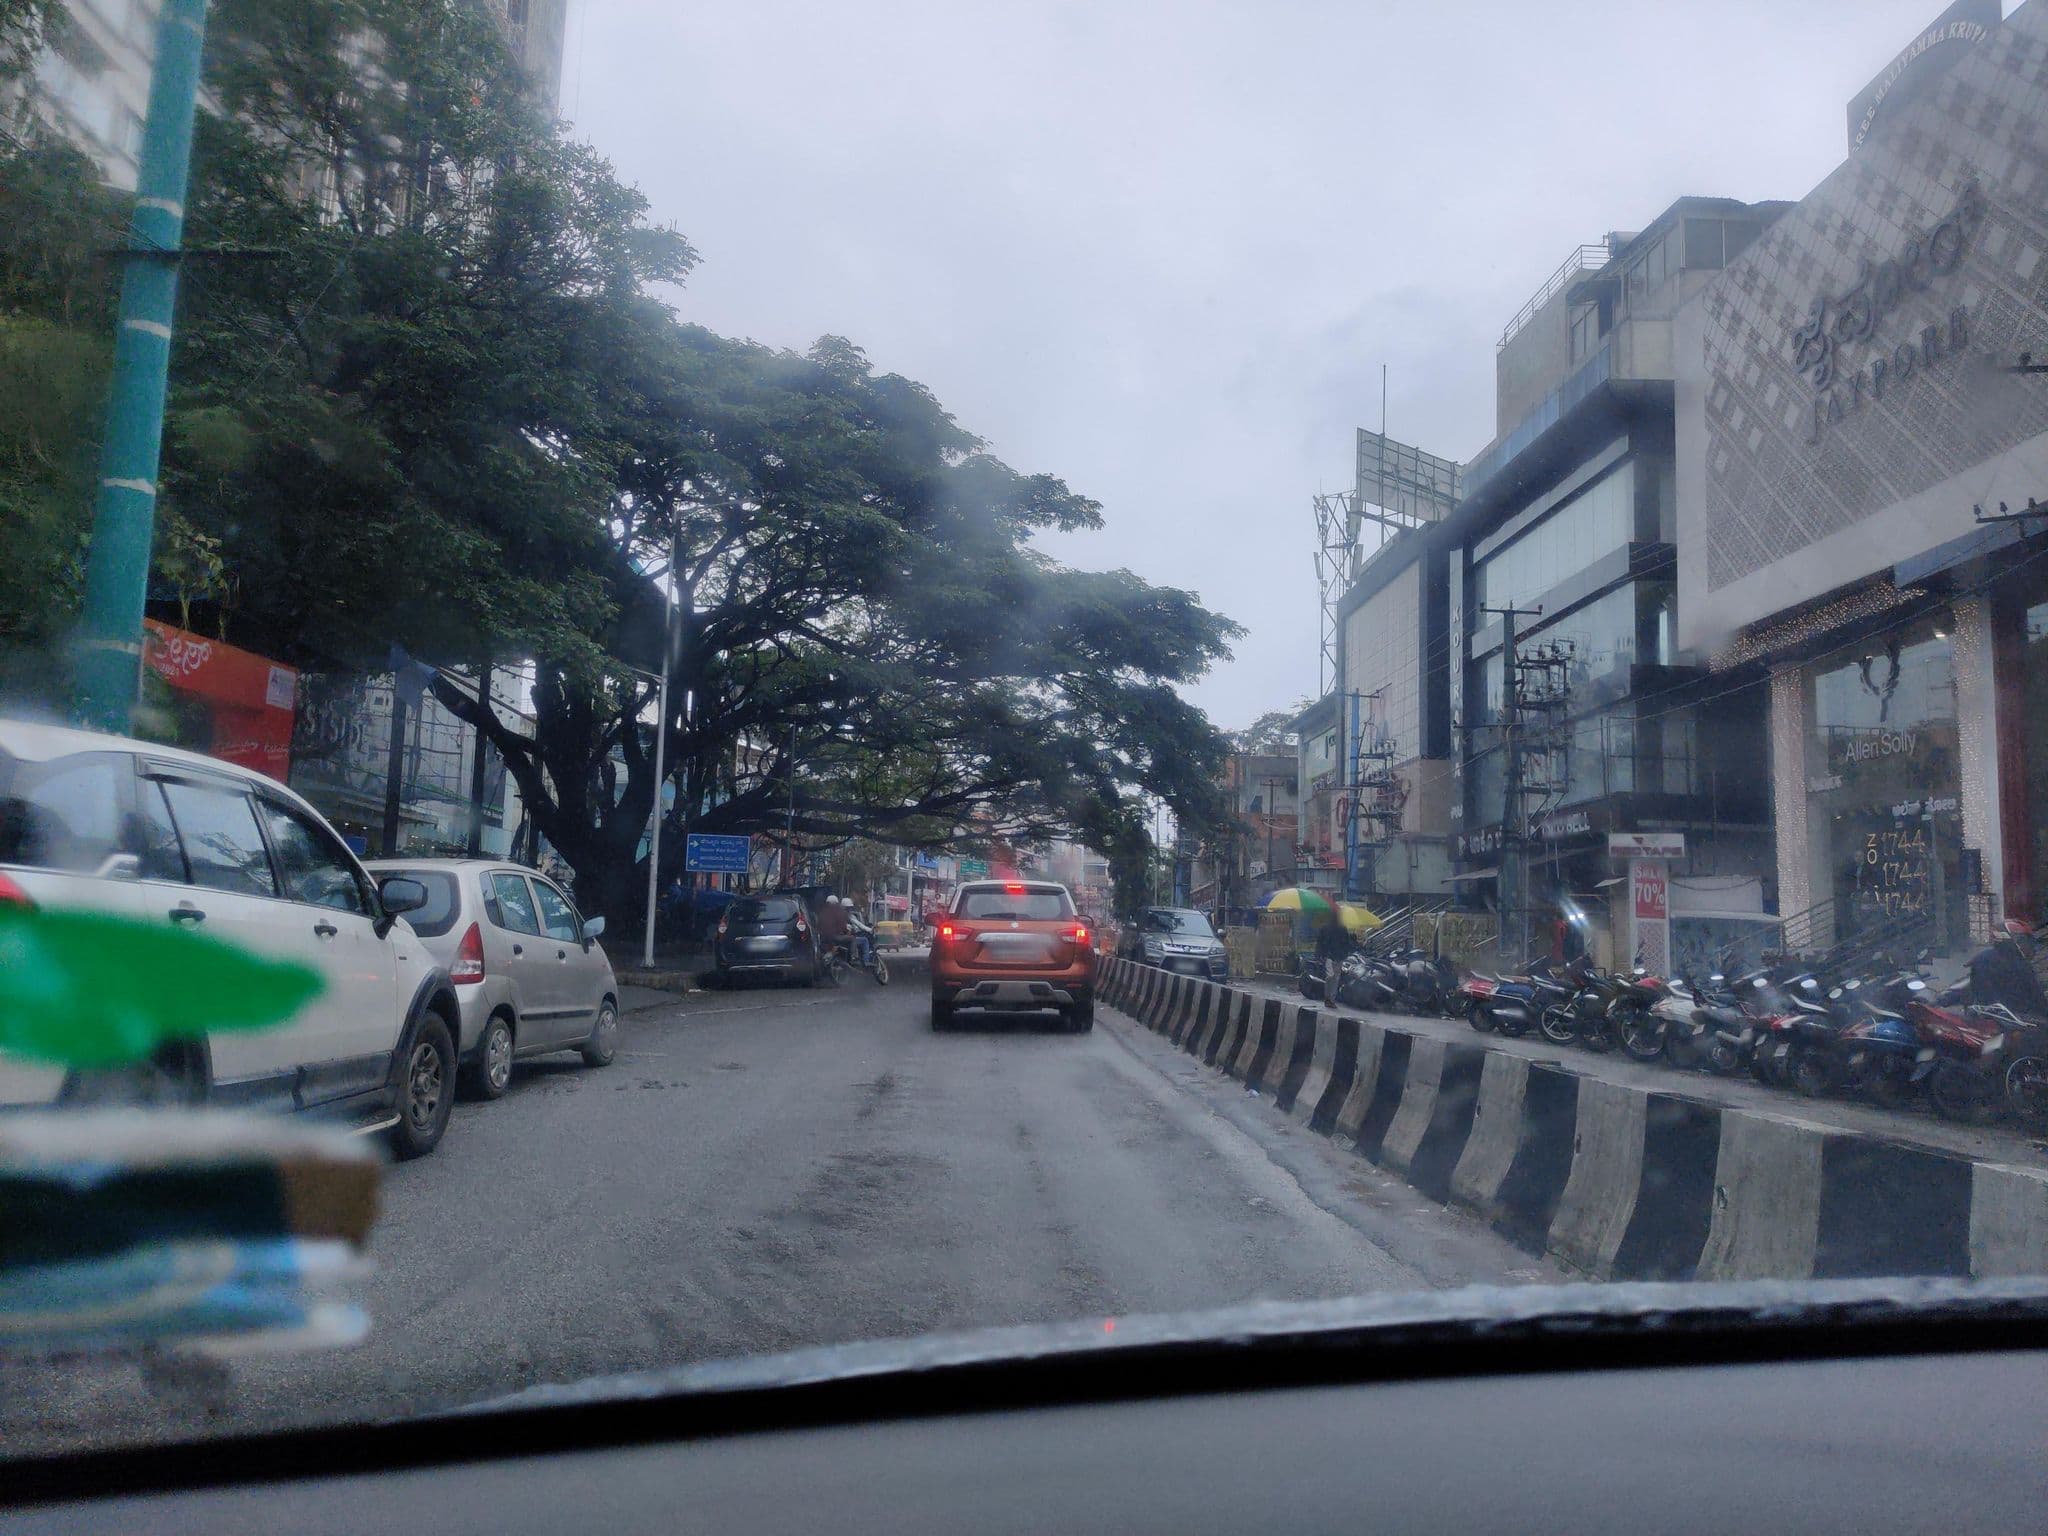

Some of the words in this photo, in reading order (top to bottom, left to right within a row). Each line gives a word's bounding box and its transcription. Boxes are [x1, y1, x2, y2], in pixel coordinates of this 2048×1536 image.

[1851, 105, 1877, 153] REE
[1845, 740, 1880, 762] Allen
[1880, 729, 1917, 756] Solly
[1635, 882, 1666, 905] 70%
